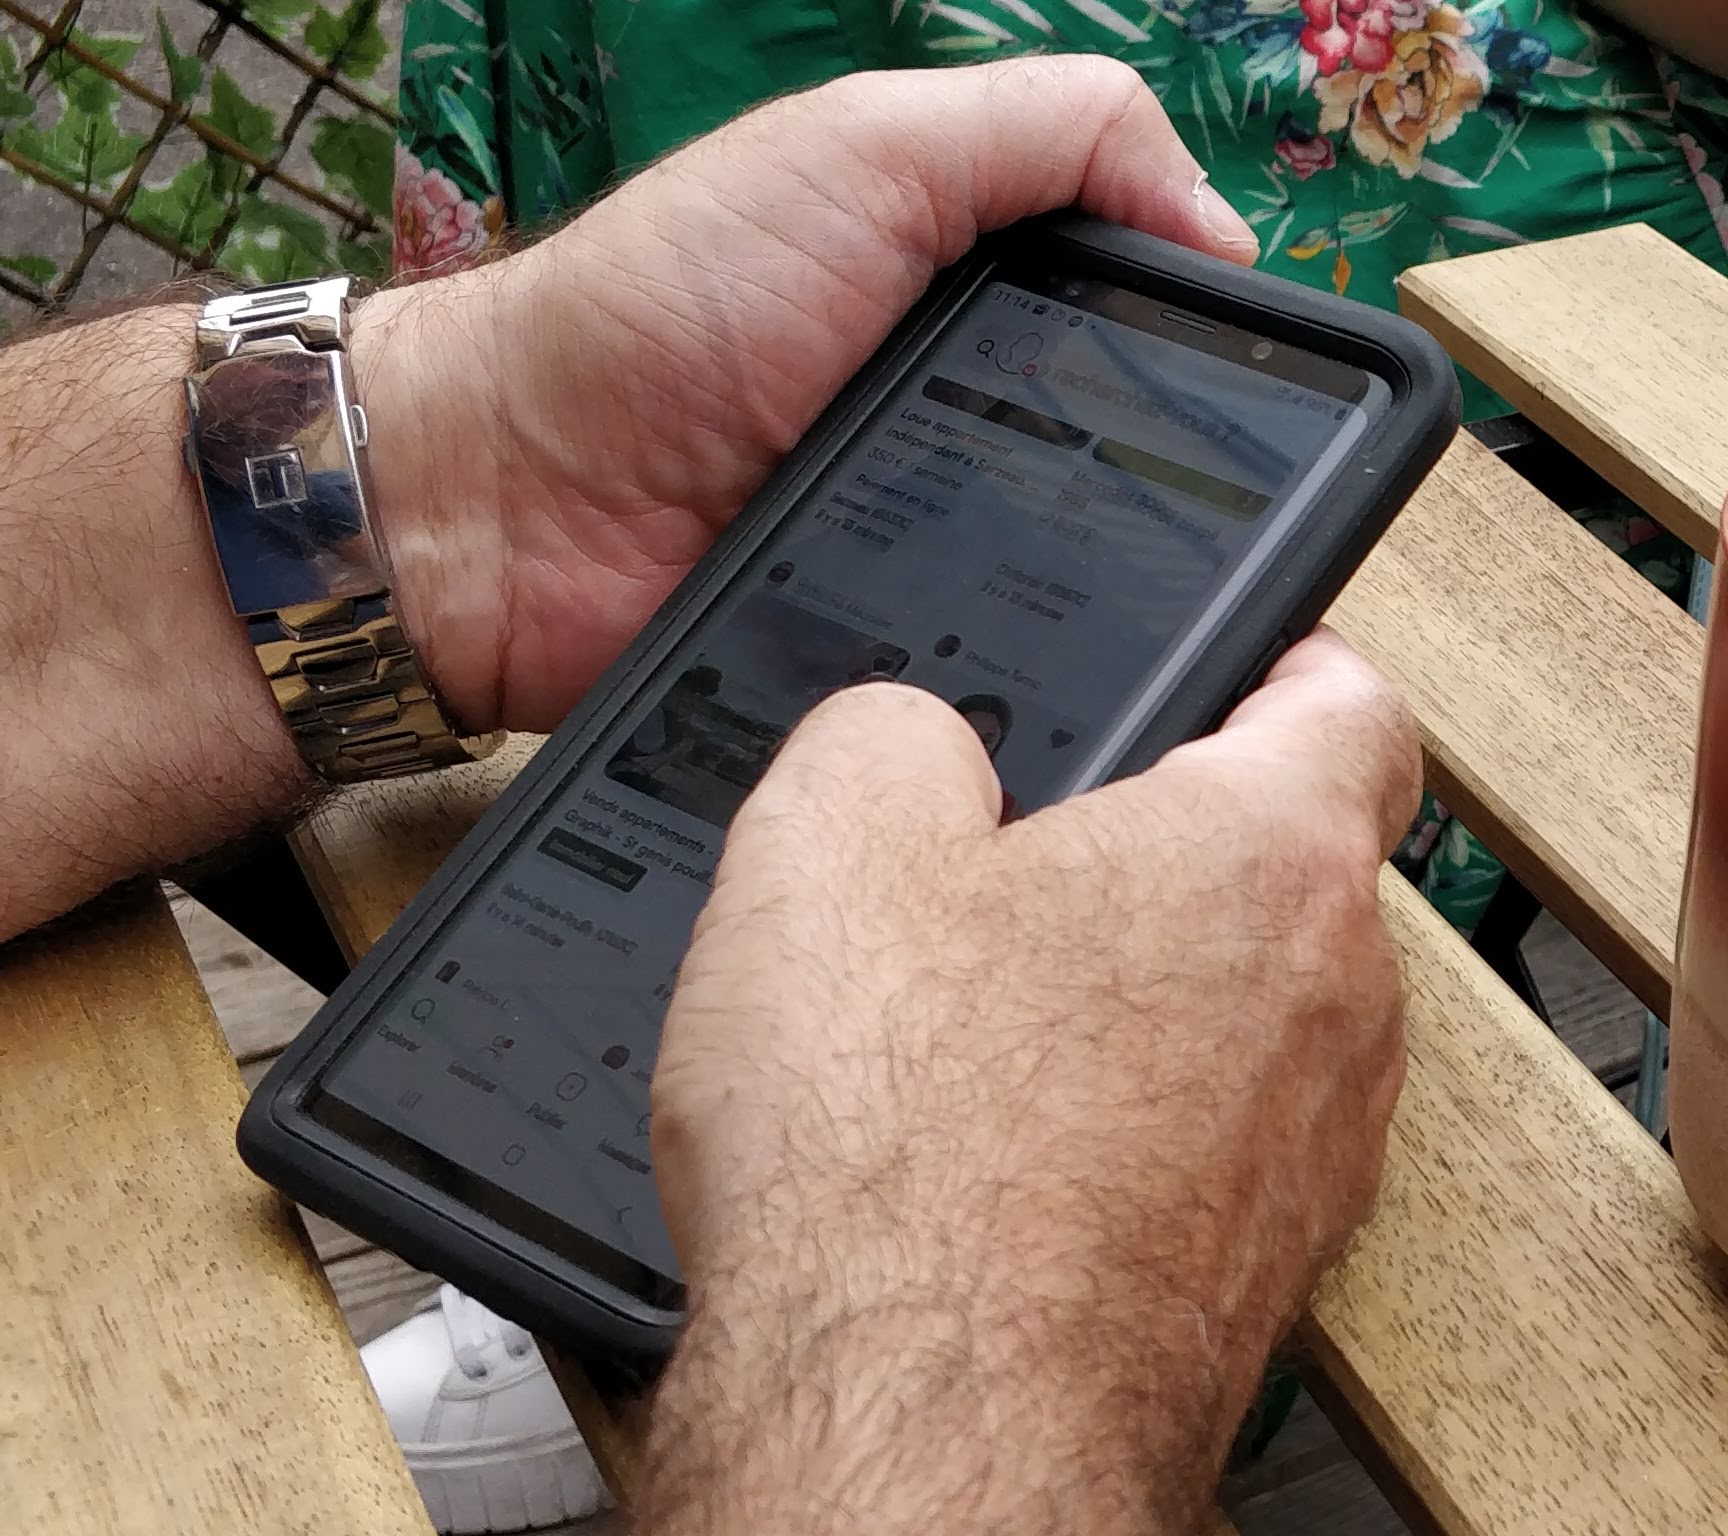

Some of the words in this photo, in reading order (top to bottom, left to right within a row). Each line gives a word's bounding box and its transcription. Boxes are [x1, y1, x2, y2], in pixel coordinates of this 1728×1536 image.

[993, 289, 1031, 311] 11:14
[900, 407, 932, 427] Loue
[932, 421, 1014, 457] appartement
[855, 473, 907, 499] Paiement
[914, 465, 963, 491] semaine
[582, 788, 619, 814] Vends
[619, 810, 707, 854] appartements
